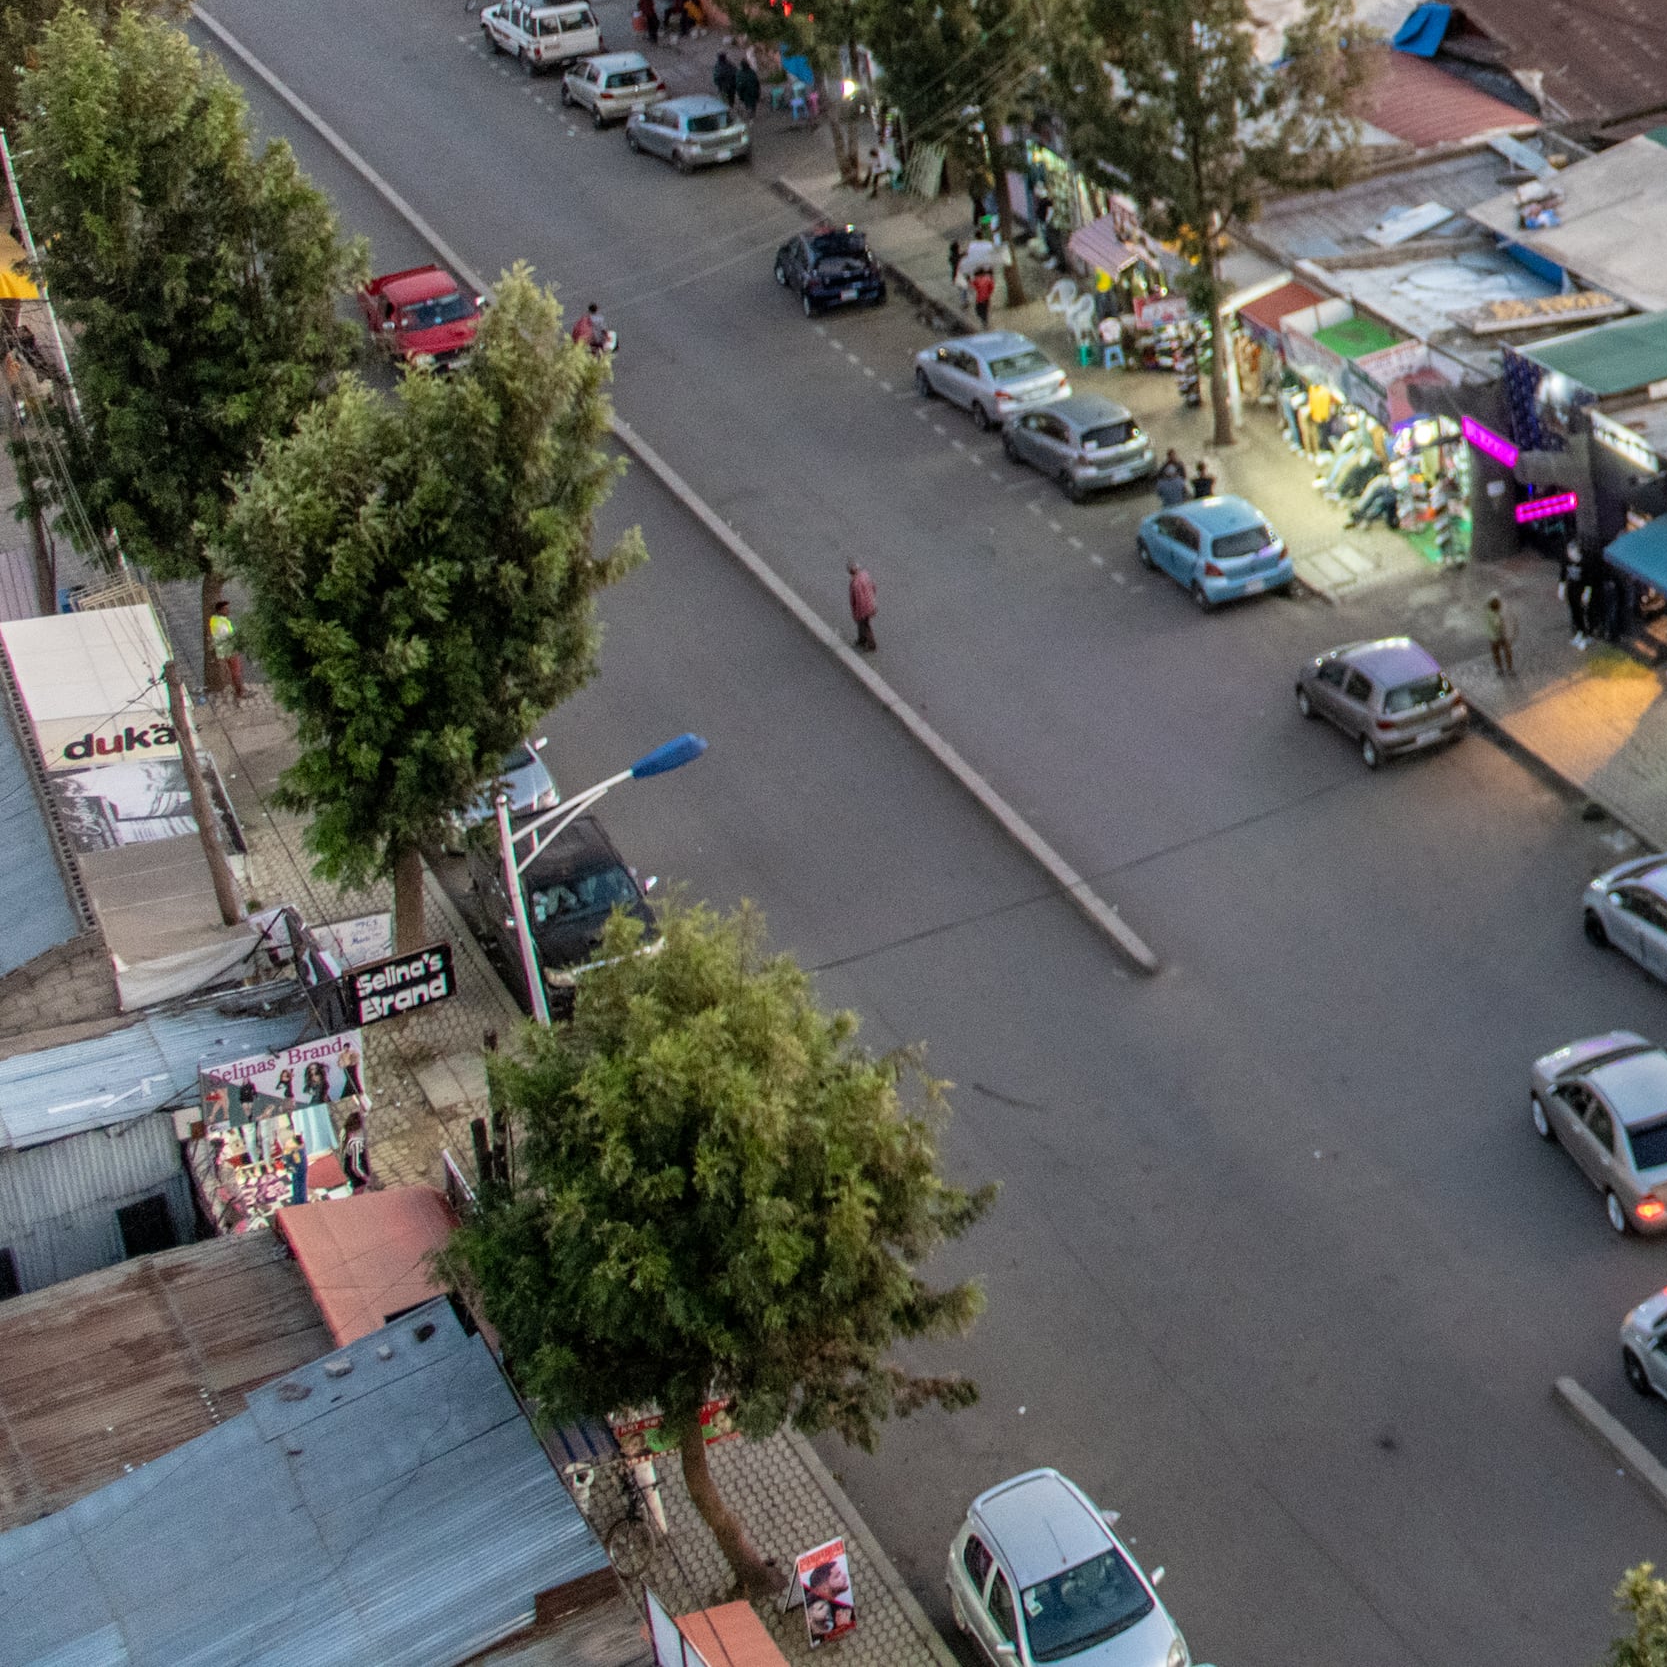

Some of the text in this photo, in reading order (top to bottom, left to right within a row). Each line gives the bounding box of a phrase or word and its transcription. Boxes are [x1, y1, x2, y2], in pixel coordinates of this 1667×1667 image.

[356, 952, 443, 998] Selina's
[360, 972, 449, 1025] Brand
[208, 1036, 343, 1084] Selinas Brand
